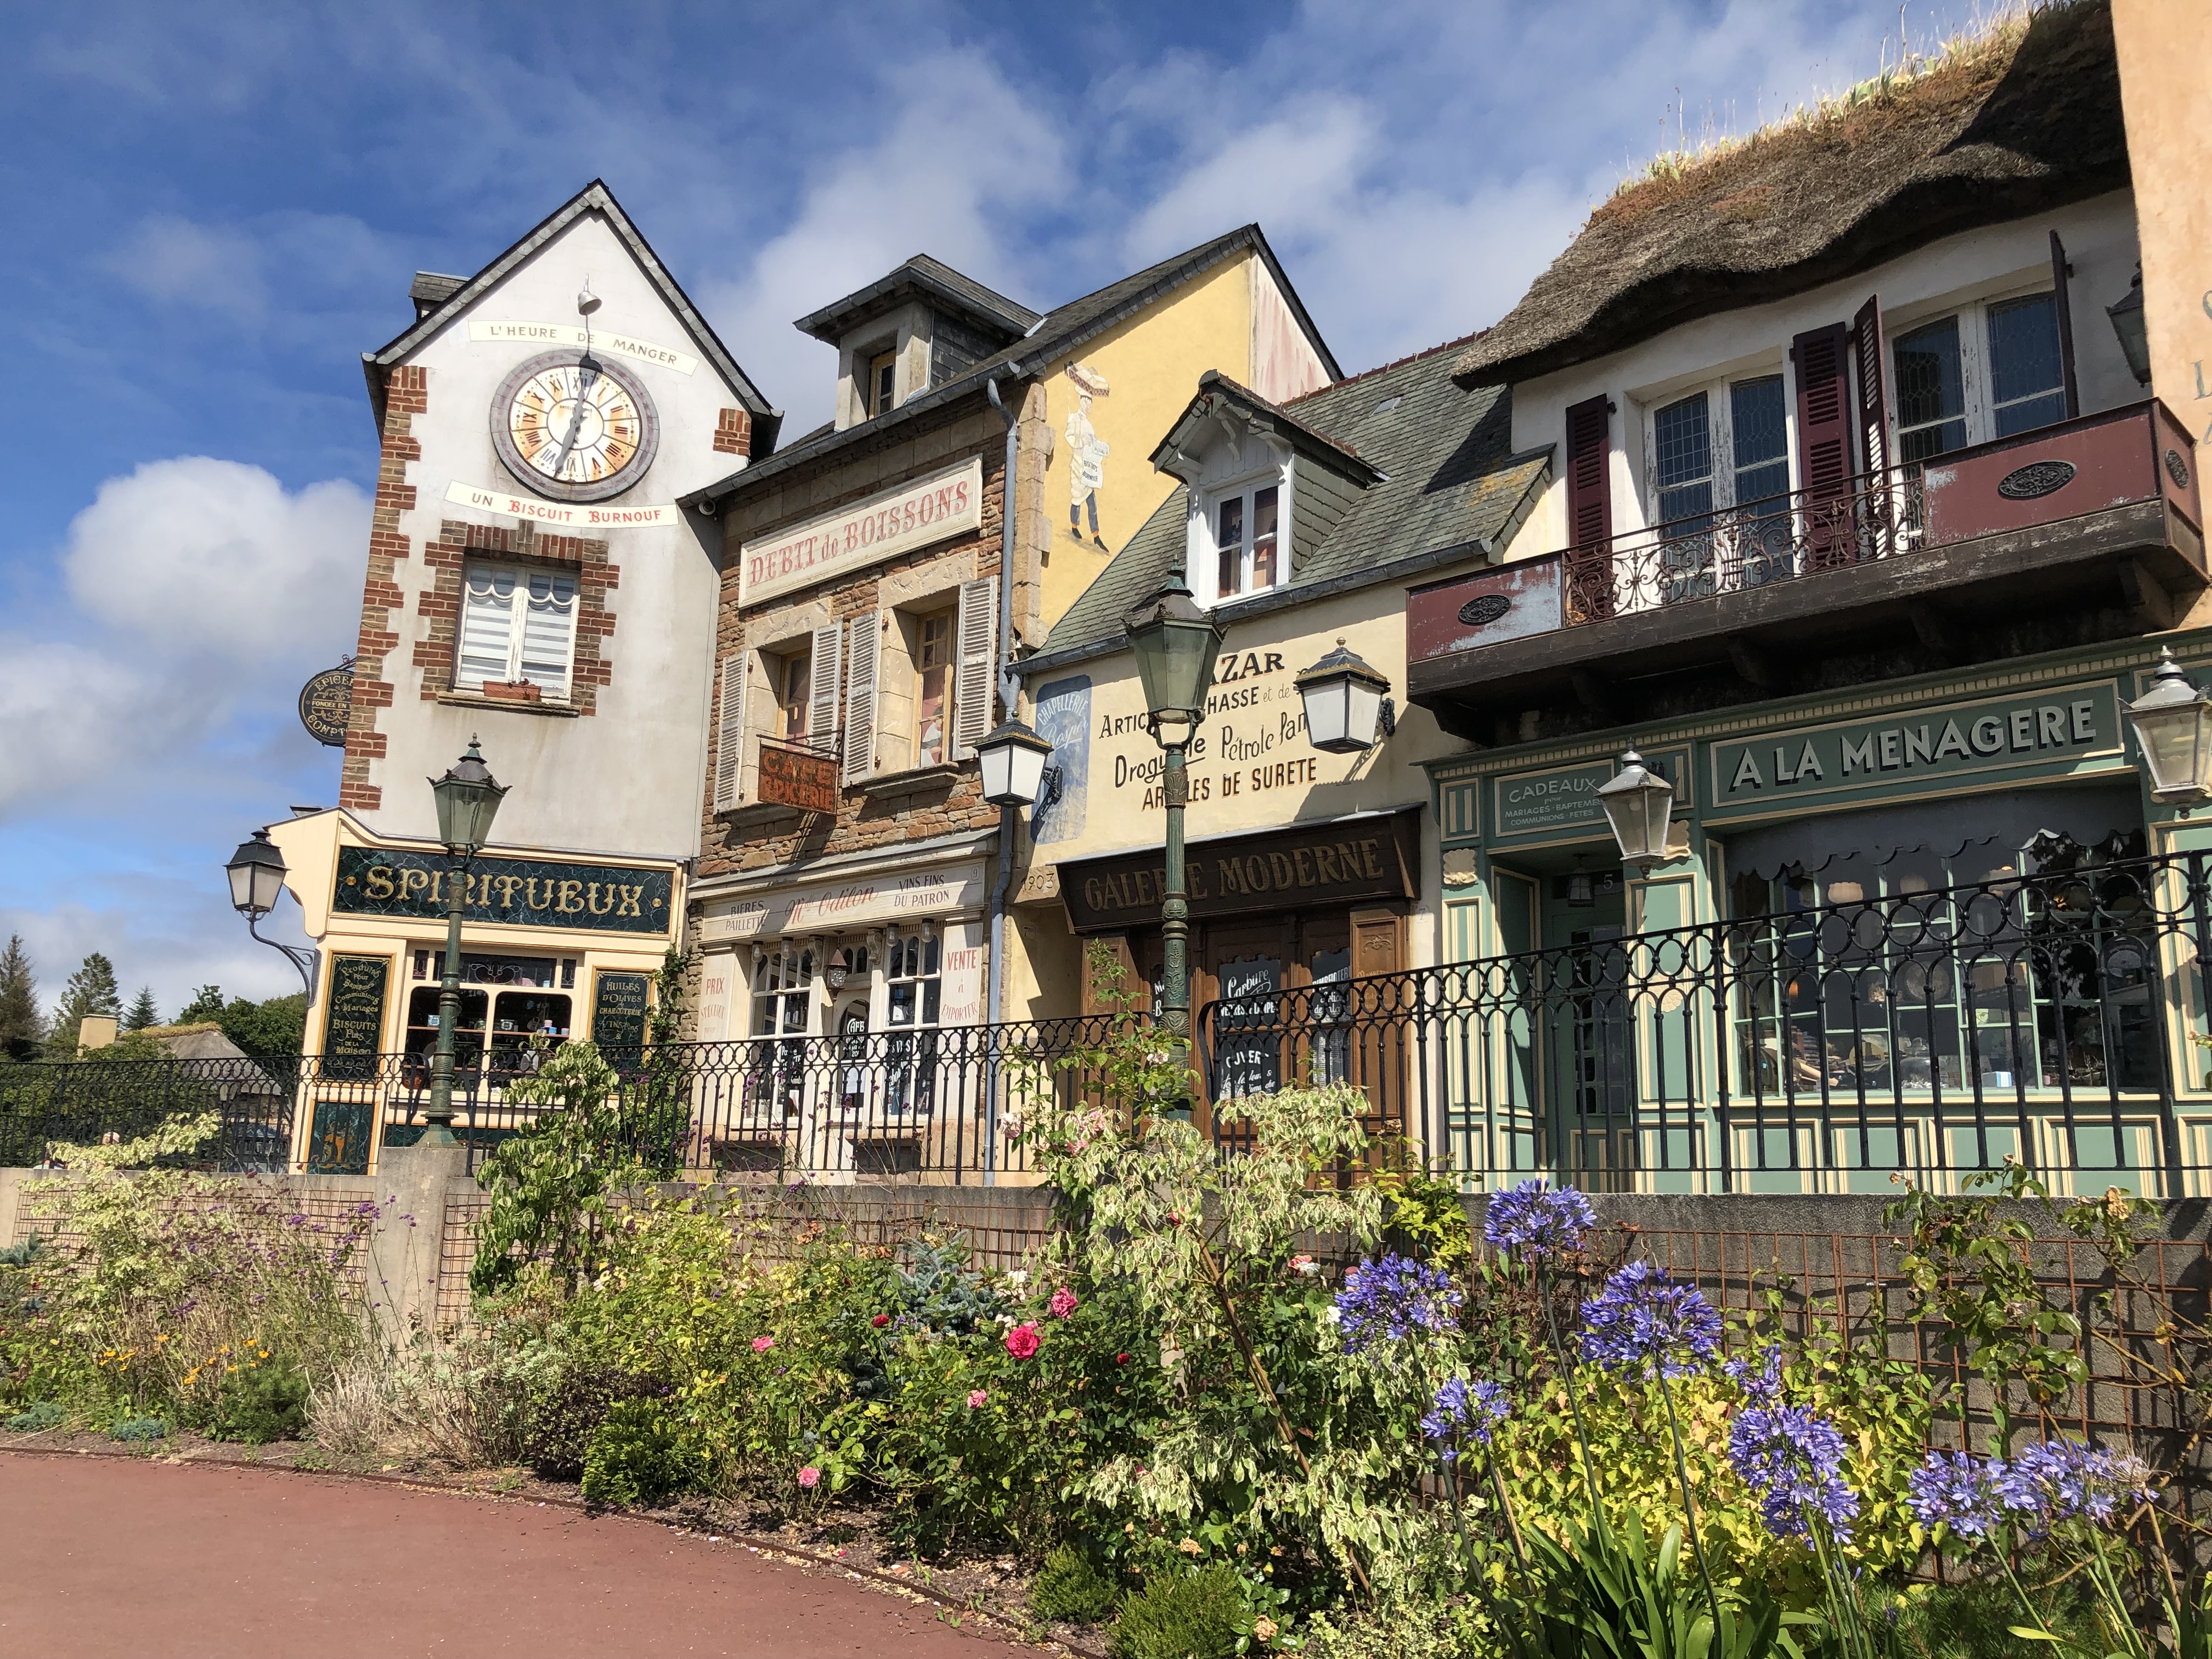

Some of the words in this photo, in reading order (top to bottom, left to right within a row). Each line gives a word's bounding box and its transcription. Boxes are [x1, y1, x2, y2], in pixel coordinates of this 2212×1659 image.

[490, 325, 557, 339] L'HEURE
[577, 332, 595, 343] DE
[613, 338, 678, 365] MANGER
[531, 392, 545, 404] X
[472, 493, 493, 507] UN
[508, 499, 573, 523] BISCUIT
[588, 510, 662, 524] BURNOUF
[749, 536, 817, 585] DEBIT
[822, 534, 838, 562] de
[843, 481, 968, 552] BOISSONS
[1209, 652, 1285, 687] ZAR
[1037, 693, 1089, 726] CHAPELLERIE
[1098, 713, 1147, 740] ARTIC
[1206, 686, 1259, 715] HASSE
[1263, 686, 1273, 702] et
[1278, 683, 1290, 699] de
[1221, 724, 1274, 762] Pétrole
[1279, 712, 1308, 746] Pan
[1730, 748, 1763, 790] A
[1774, 739, 1824, 784] LA
[1842, 699, 2097, 775] MENAGERE
[1141, 777, 1210, 811] ARLES
[1222, 771, 1241, 797] DE
[1251, 758, 1317, 792] SURETE
[1509, 778, 1596, 803] CADEAUX
[1505, 806, 1550, 818] MARIAGES
[1556, 799, 1601, 811] BAPTEMES
[1511, 813, 1564, 826] COMMUNIONS
[1570, 809, 1594, 818] FETES
[899, 876, 921, 892] VINS
[924, 874, 945, 887] FINS
[1020, 873, 1054, 891] 1903
[1085, 863, 1207, 912] GALEE
[1217, 839, 1384, 897] MODERNE
[1603, 874, 1613, 890] 5
[818, 884, 878, 916] Odilon
[894, 894, 907, 907] DU
[911, 889, 950, 907] PATRON
[725, 916, 766, 931] PAILLETTE
[947, 949, 977, 971] VENTE
[341, 963, 382, 978] Produits
[606, 981, 640, 992] HUILES
[706, 978, 725, 995] PRIX
[1228, 969, 1272, 998] Carbure
[335, 992, 380, 1005] Communions
[342, 1003, 379, 1013] Mariages
[602, 994, 642, 1003] D'OLIVES
[941, 1002, 978, 1021] EMPORTER
[332, 1019, 376, 1030] BISCUITS
